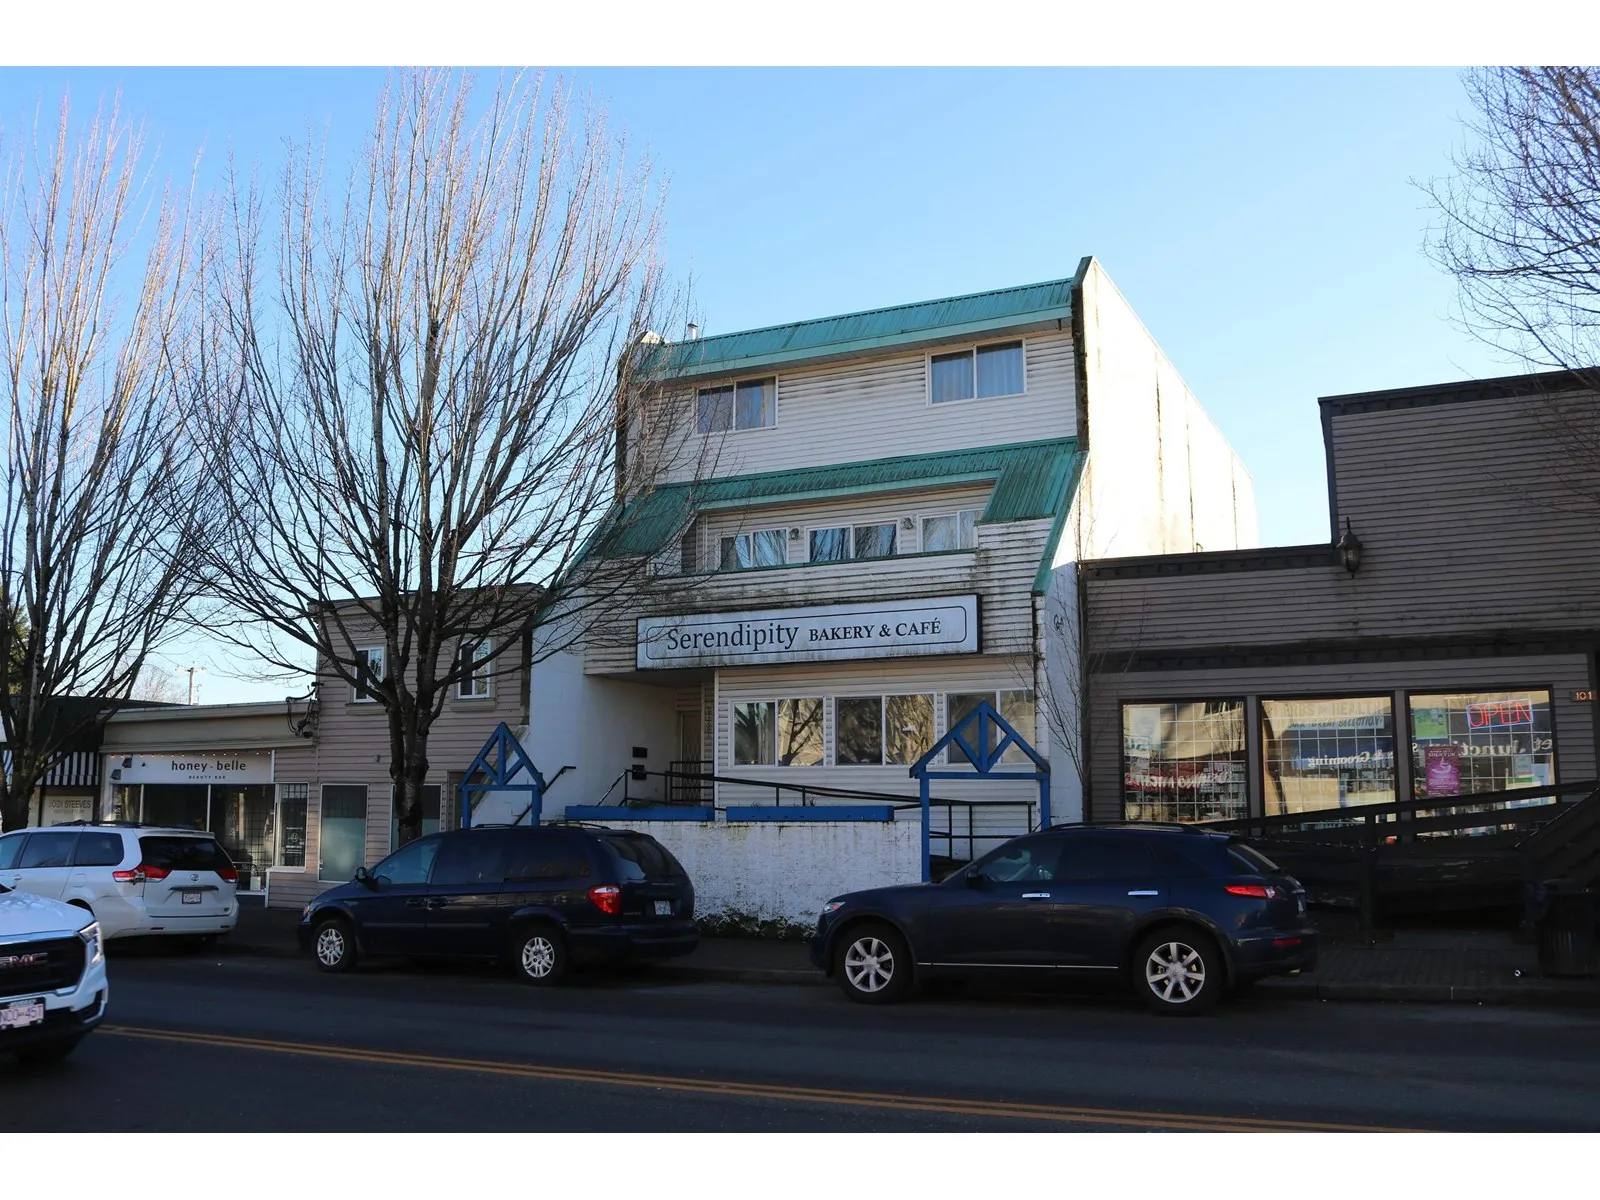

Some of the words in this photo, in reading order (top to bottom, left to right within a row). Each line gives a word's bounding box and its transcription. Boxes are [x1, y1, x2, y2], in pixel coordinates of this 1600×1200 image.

[667, 622, 799, 651] Serendipity
[808, 624, 875, 642] BAKERY
[879, 623, 891, 637] &
[895, 617, 941, 637] CAFÉ
[1576, 691, 1592, 700] 101
[1468, 701, 1531, 727] OPEN
[171, 760, 208, 773] honey
[216, 760, 246, 771] belle
